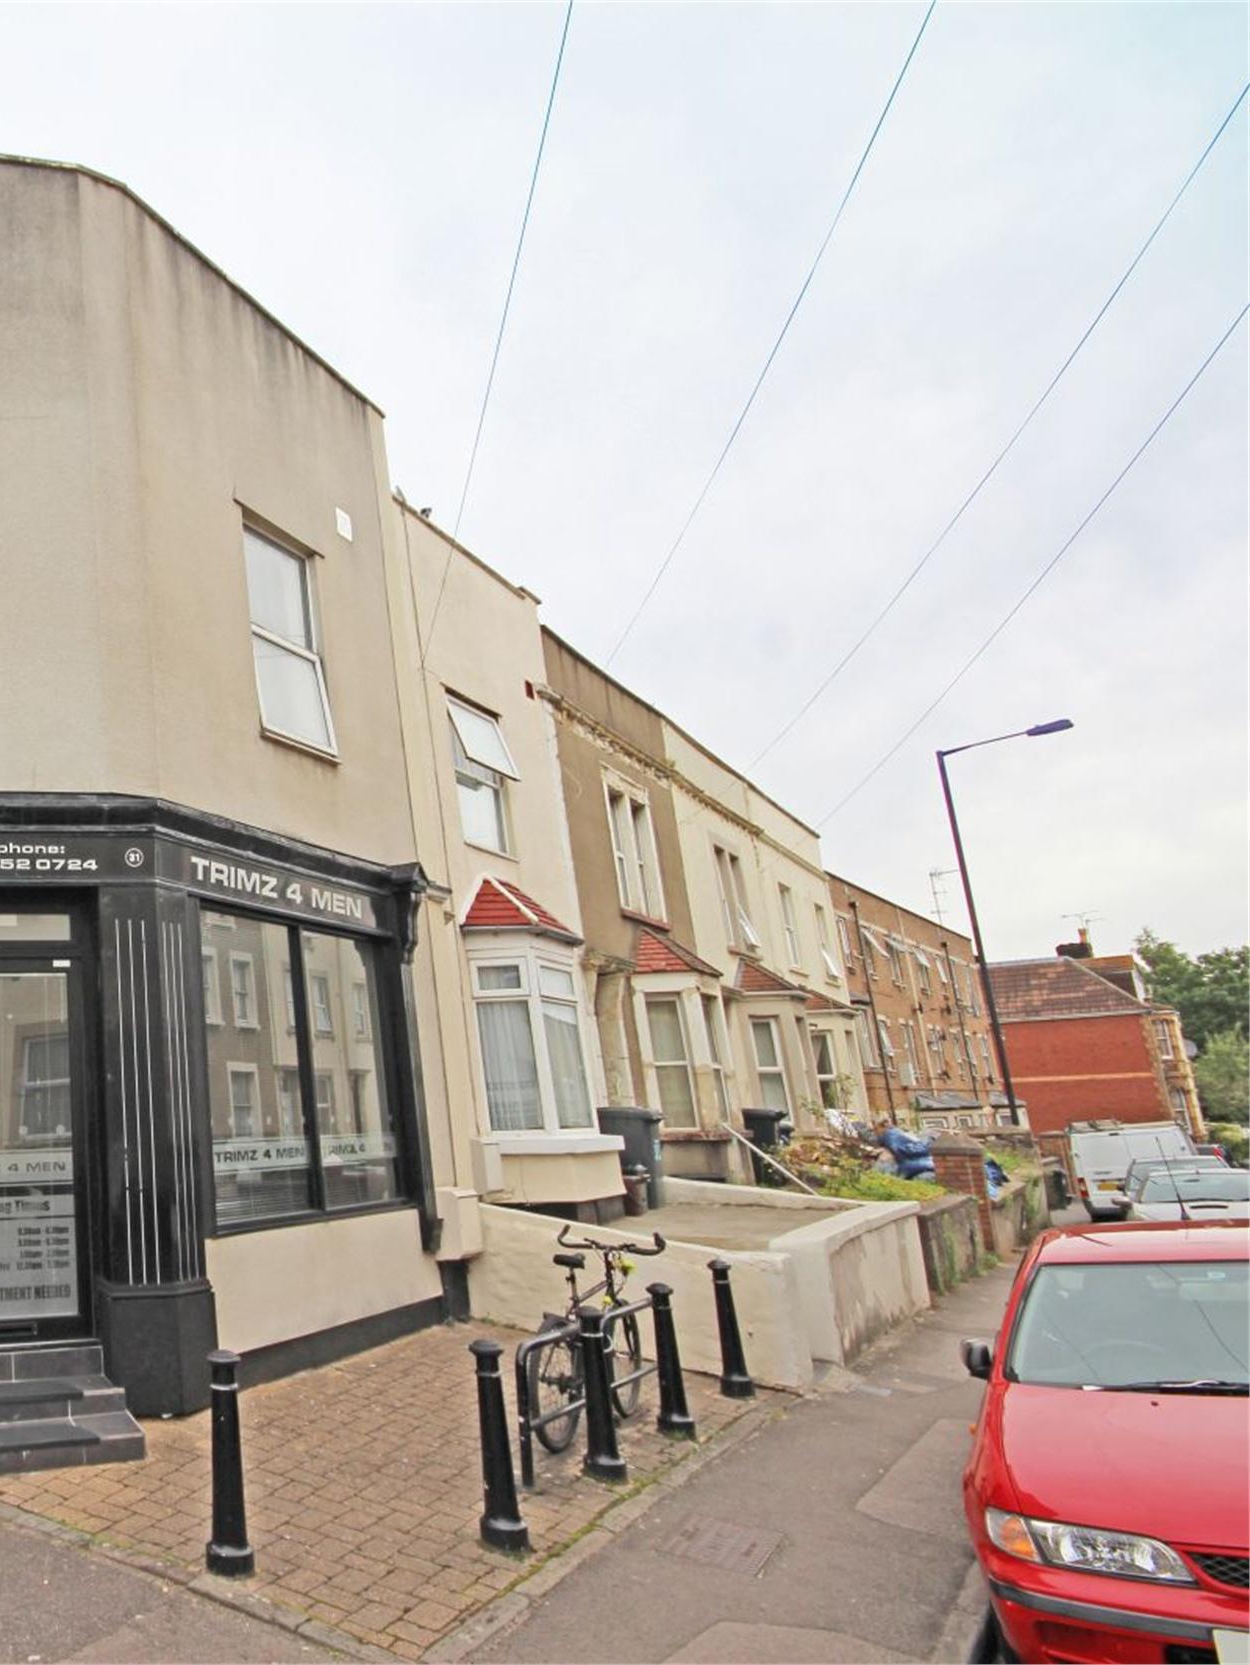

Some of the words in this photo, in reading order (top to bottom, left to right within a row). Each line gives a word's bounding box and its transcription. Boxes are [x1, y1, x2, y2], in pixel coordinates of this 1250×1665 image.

[36, 858, 98, 871] 0724
[190, 856, 278, 898] TRIMZ
[286, 883, 303, 904] 4
[311, 888, 363, 919] MEN
[214, 1148, 258, 1163] TRIMZ
[263, 1148, 272, 1159] 4
[7, 1163, 19, 1172] 4
[26, 1161, 66, 1173] MEN
